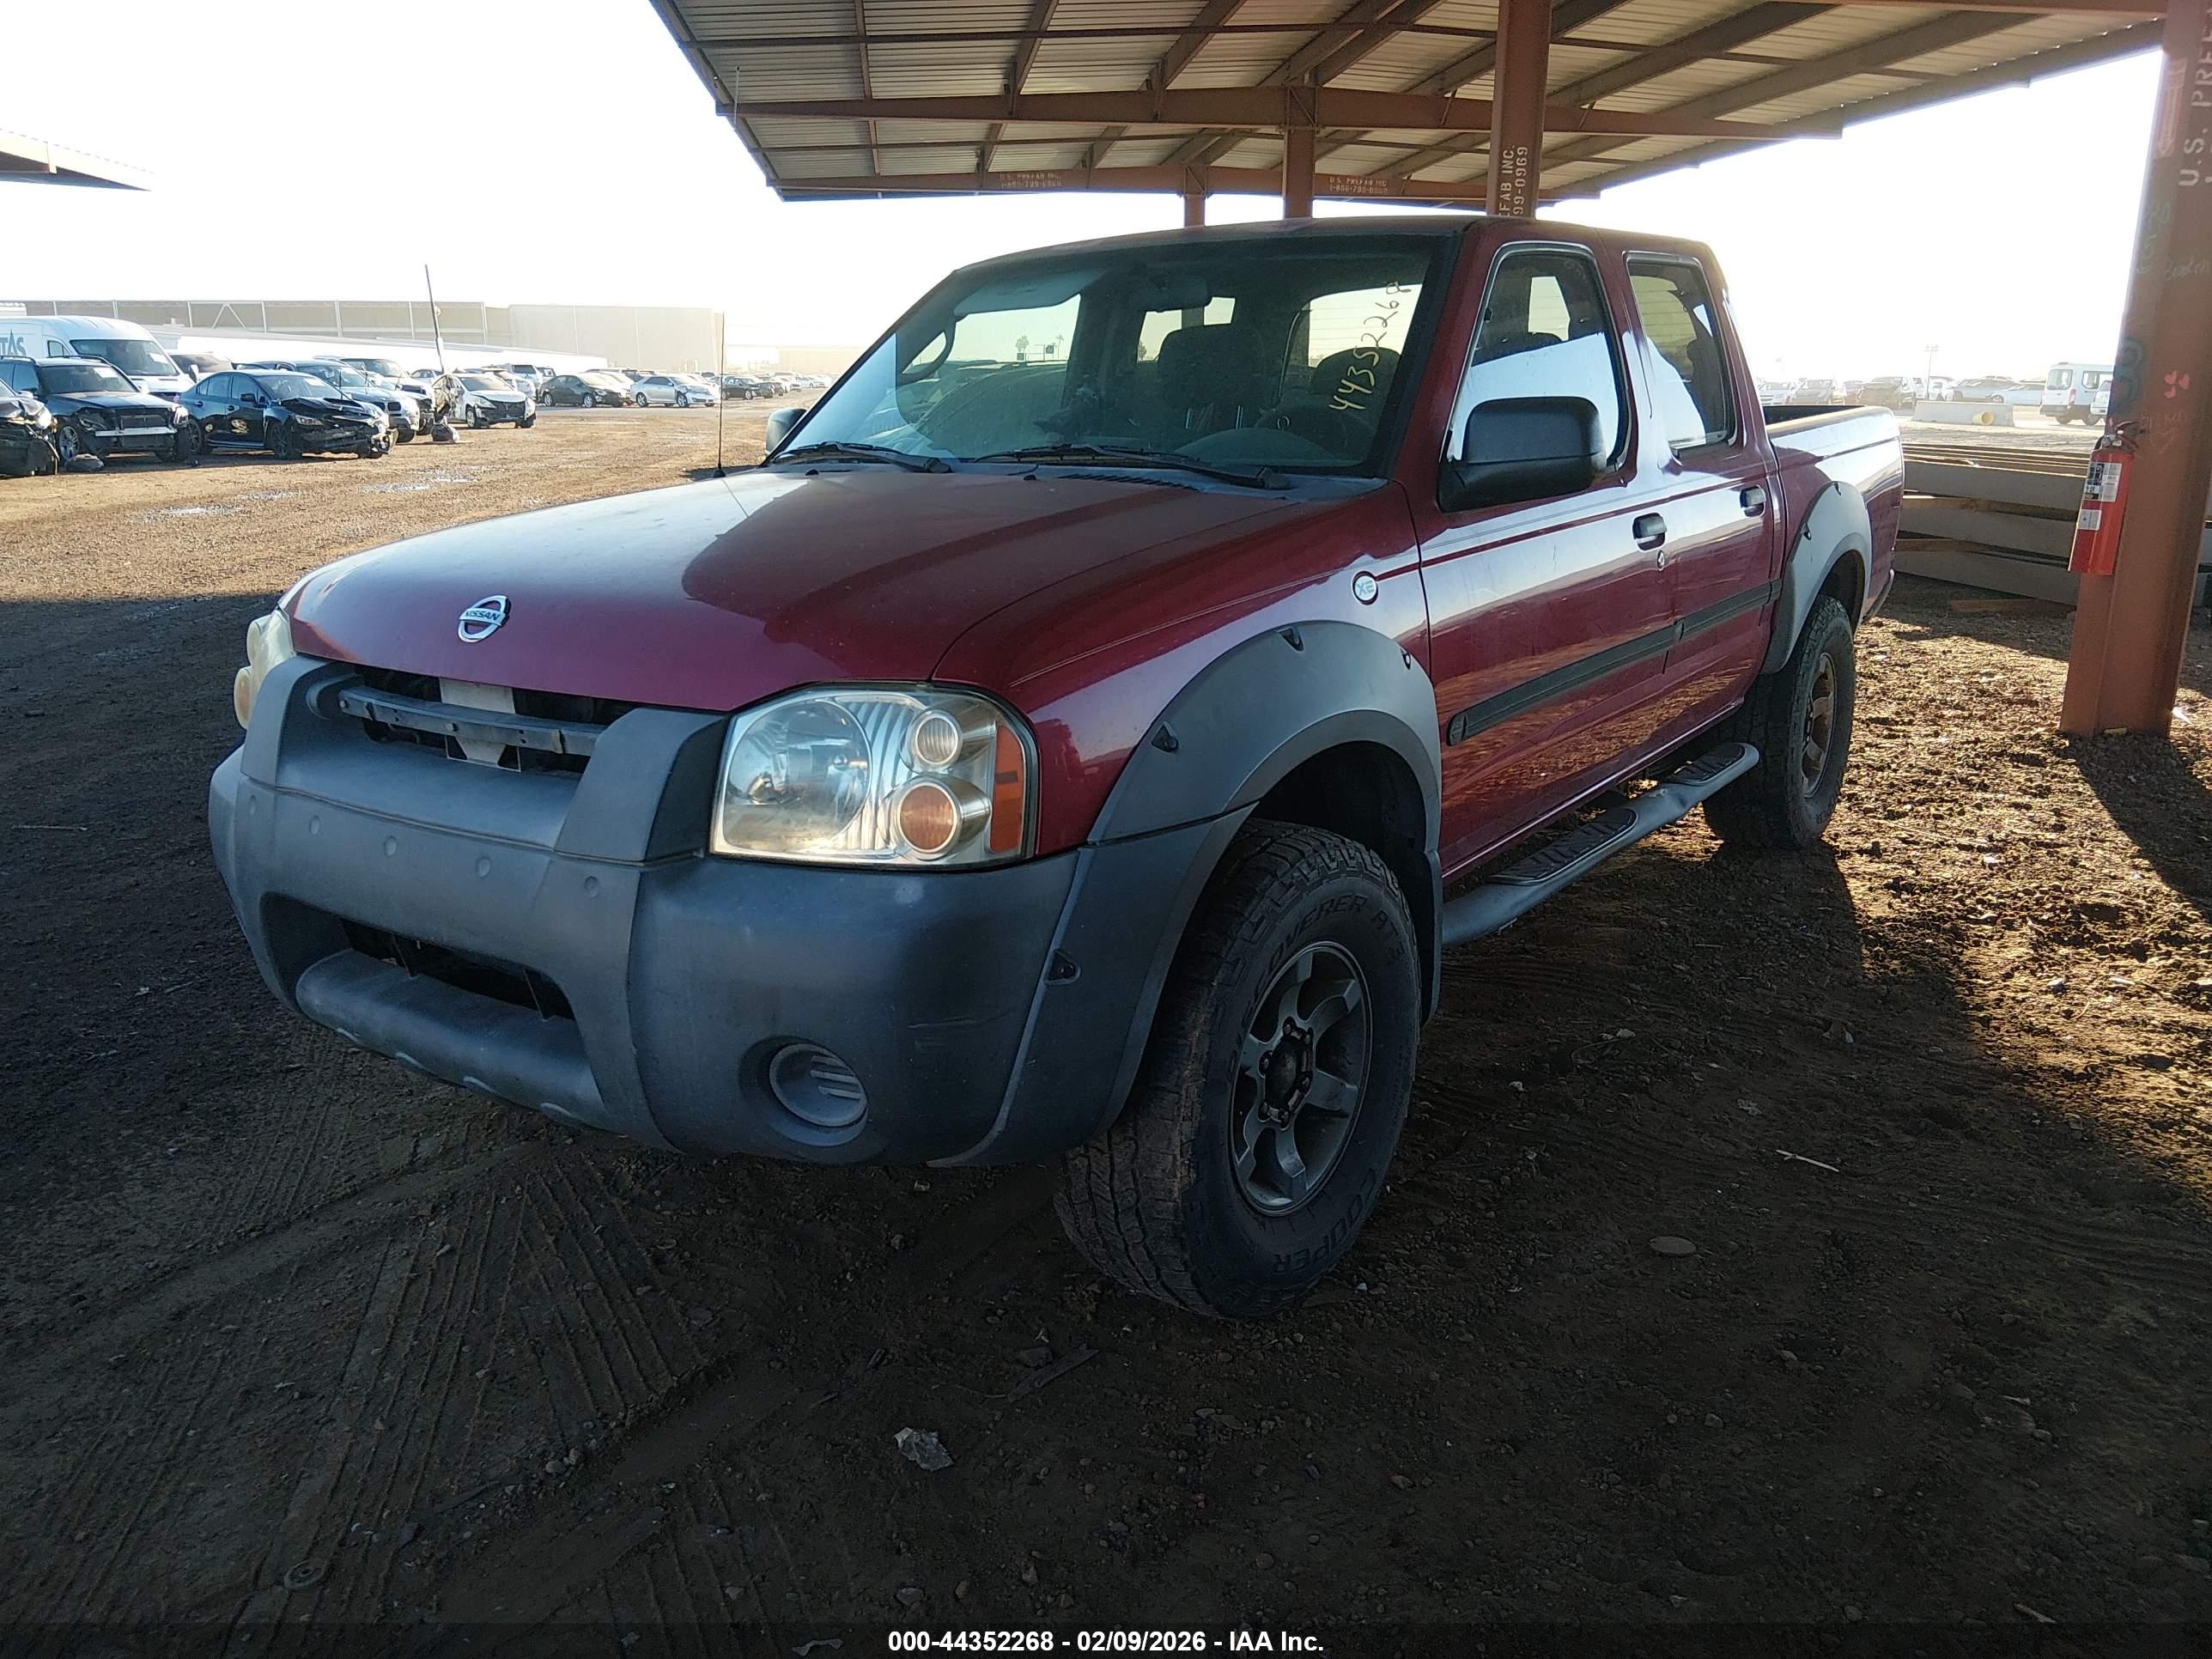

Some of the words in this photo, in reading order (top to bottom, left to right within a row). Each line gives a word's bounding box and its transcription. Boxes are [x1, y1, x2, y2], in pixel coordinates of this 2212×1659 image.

[1501, 144, 1516, 174] INC.
[1328, 281, 1412, 410] 44352268
[465, 610, 501, 621] NISSAN
[1271, 1169, 1377, 1276] COOPER
